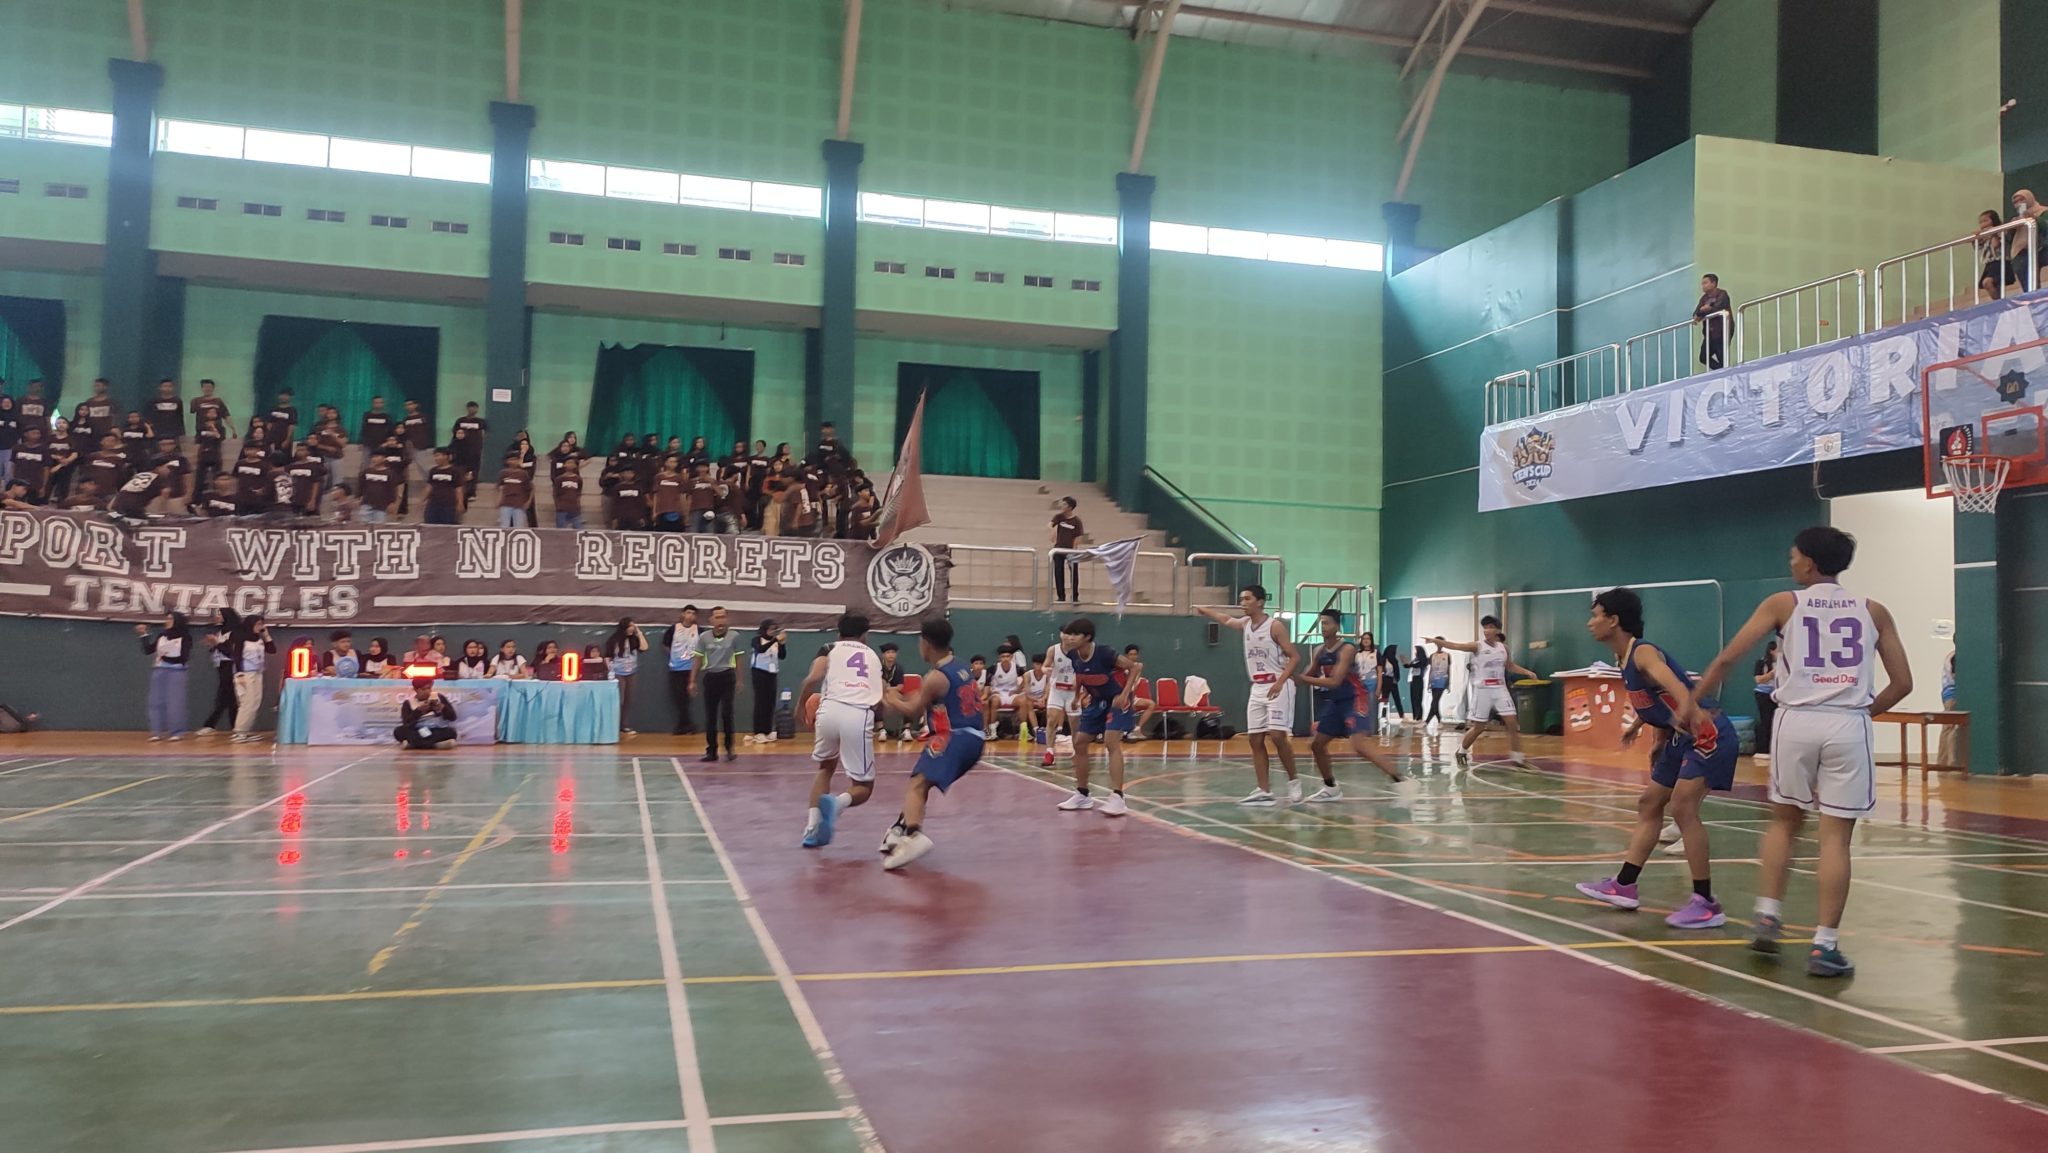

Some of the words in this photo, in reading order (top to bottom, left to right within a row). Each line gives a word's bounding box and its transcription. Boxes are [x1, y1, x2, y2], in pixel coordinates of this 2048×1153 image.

[1614, 305, 2046, 451] VICTORIA
[1534, 464, 1552, 477] CUP
[226, 528, 421, 581] WITH
[456, 528, 541, 579] NO
[575, 531, 845, 590] REGRETS
[64, 574, 360, 620] TENTACLES
[897, 601, 909, 612] 10
[1807, 598, 1857, 609] ABRAHAM
[1803, 616, 1864, 668] 13
[291, 648, 310, 679] 0
[562, 653, 579, 682] 0
[847, 651, 869, 679] 4
[1812, 673, 1839, 684] Good
[1840, 674, 1859, 686] Day
